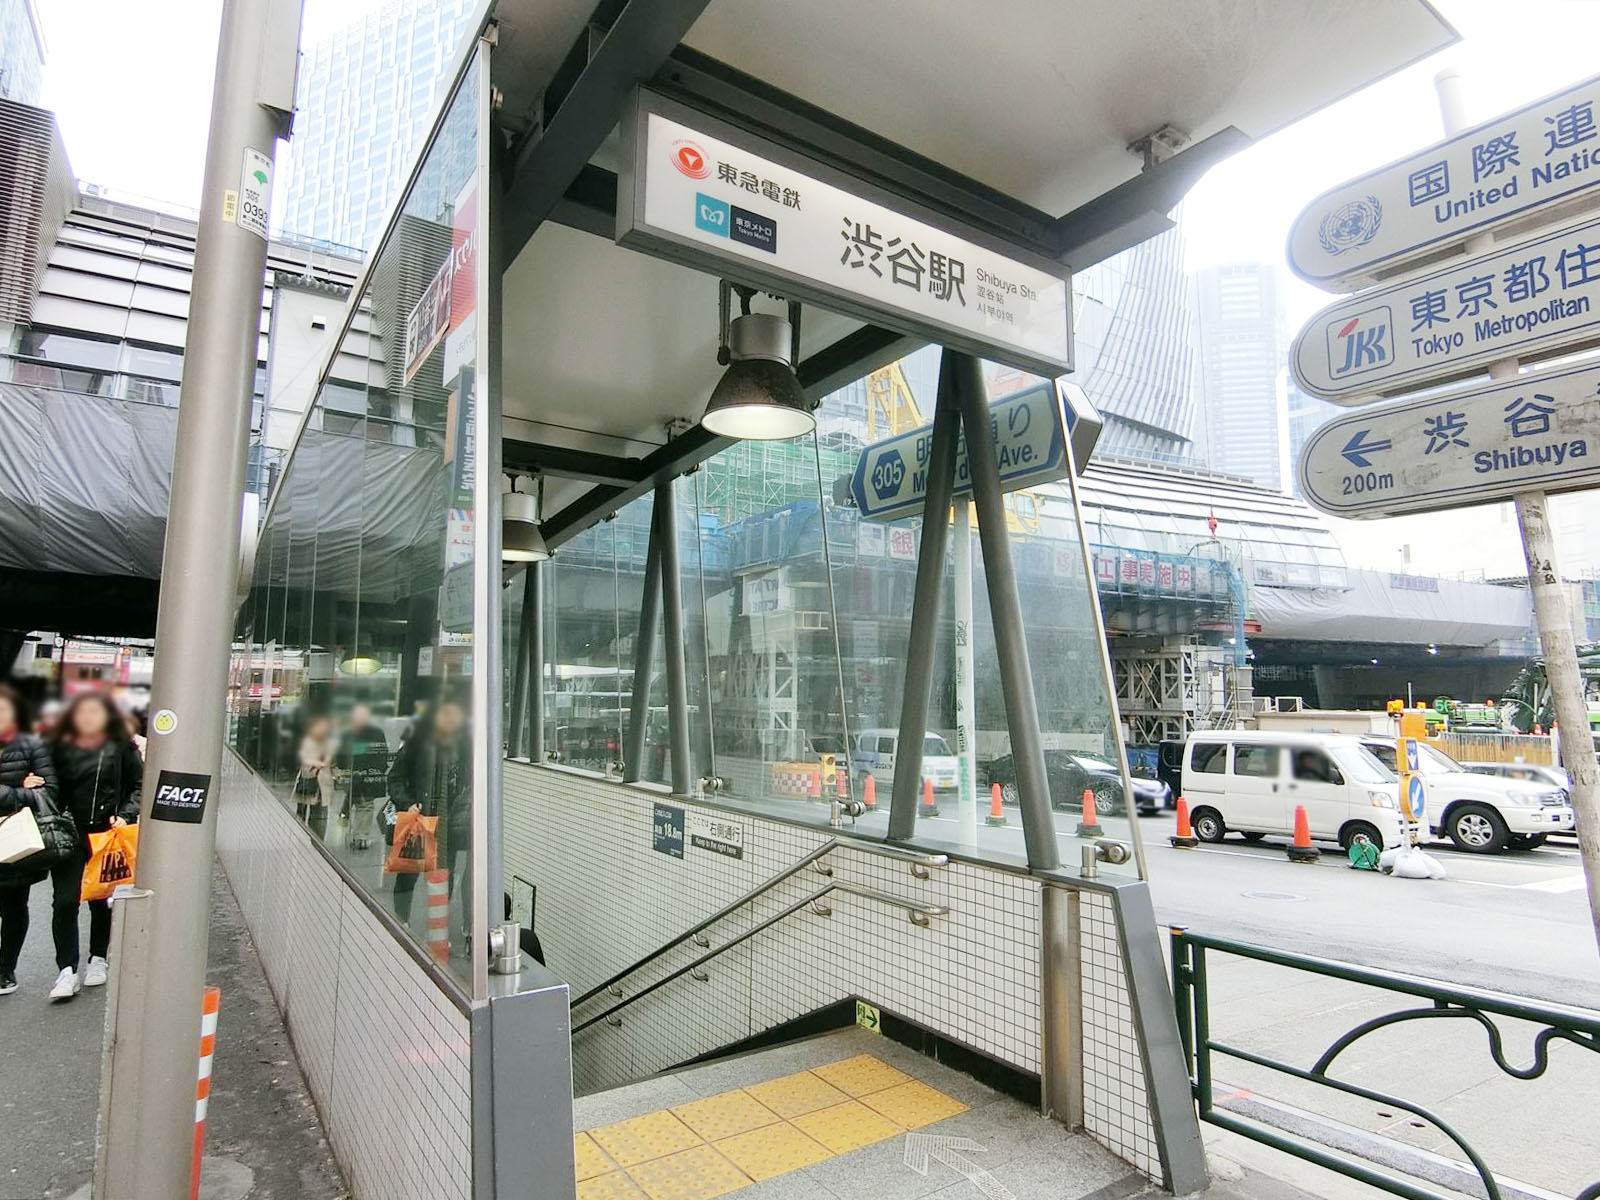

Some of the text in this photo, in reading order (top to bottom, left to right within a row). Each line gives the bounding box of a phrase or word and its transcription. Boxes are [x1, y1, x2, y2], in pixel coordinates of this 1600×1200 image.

[1408, 100, 1598, 208] 国際連
[717, 160, 801, 211] 東急電鉄
[1434, 175, 1518, 223] United
[735, 217, 772, 236] 東京メトロ
[840, 216, 966, 307] 渋谷駅
[976, 267, 1017, 295] Shibuya
[1409, 243, 1600, 334] 東京都住
[977, 302, 1015, 325] 시부야역
[1411, 296, 1590, 360] Tokyo Metropolitan
[874, 460, 903, 490] 305
[998, 443, 1038, 470] Ave.
[1342, 439, 1587, 497] 200m Shibuya
[158, 785, 205, 803] FACT.
